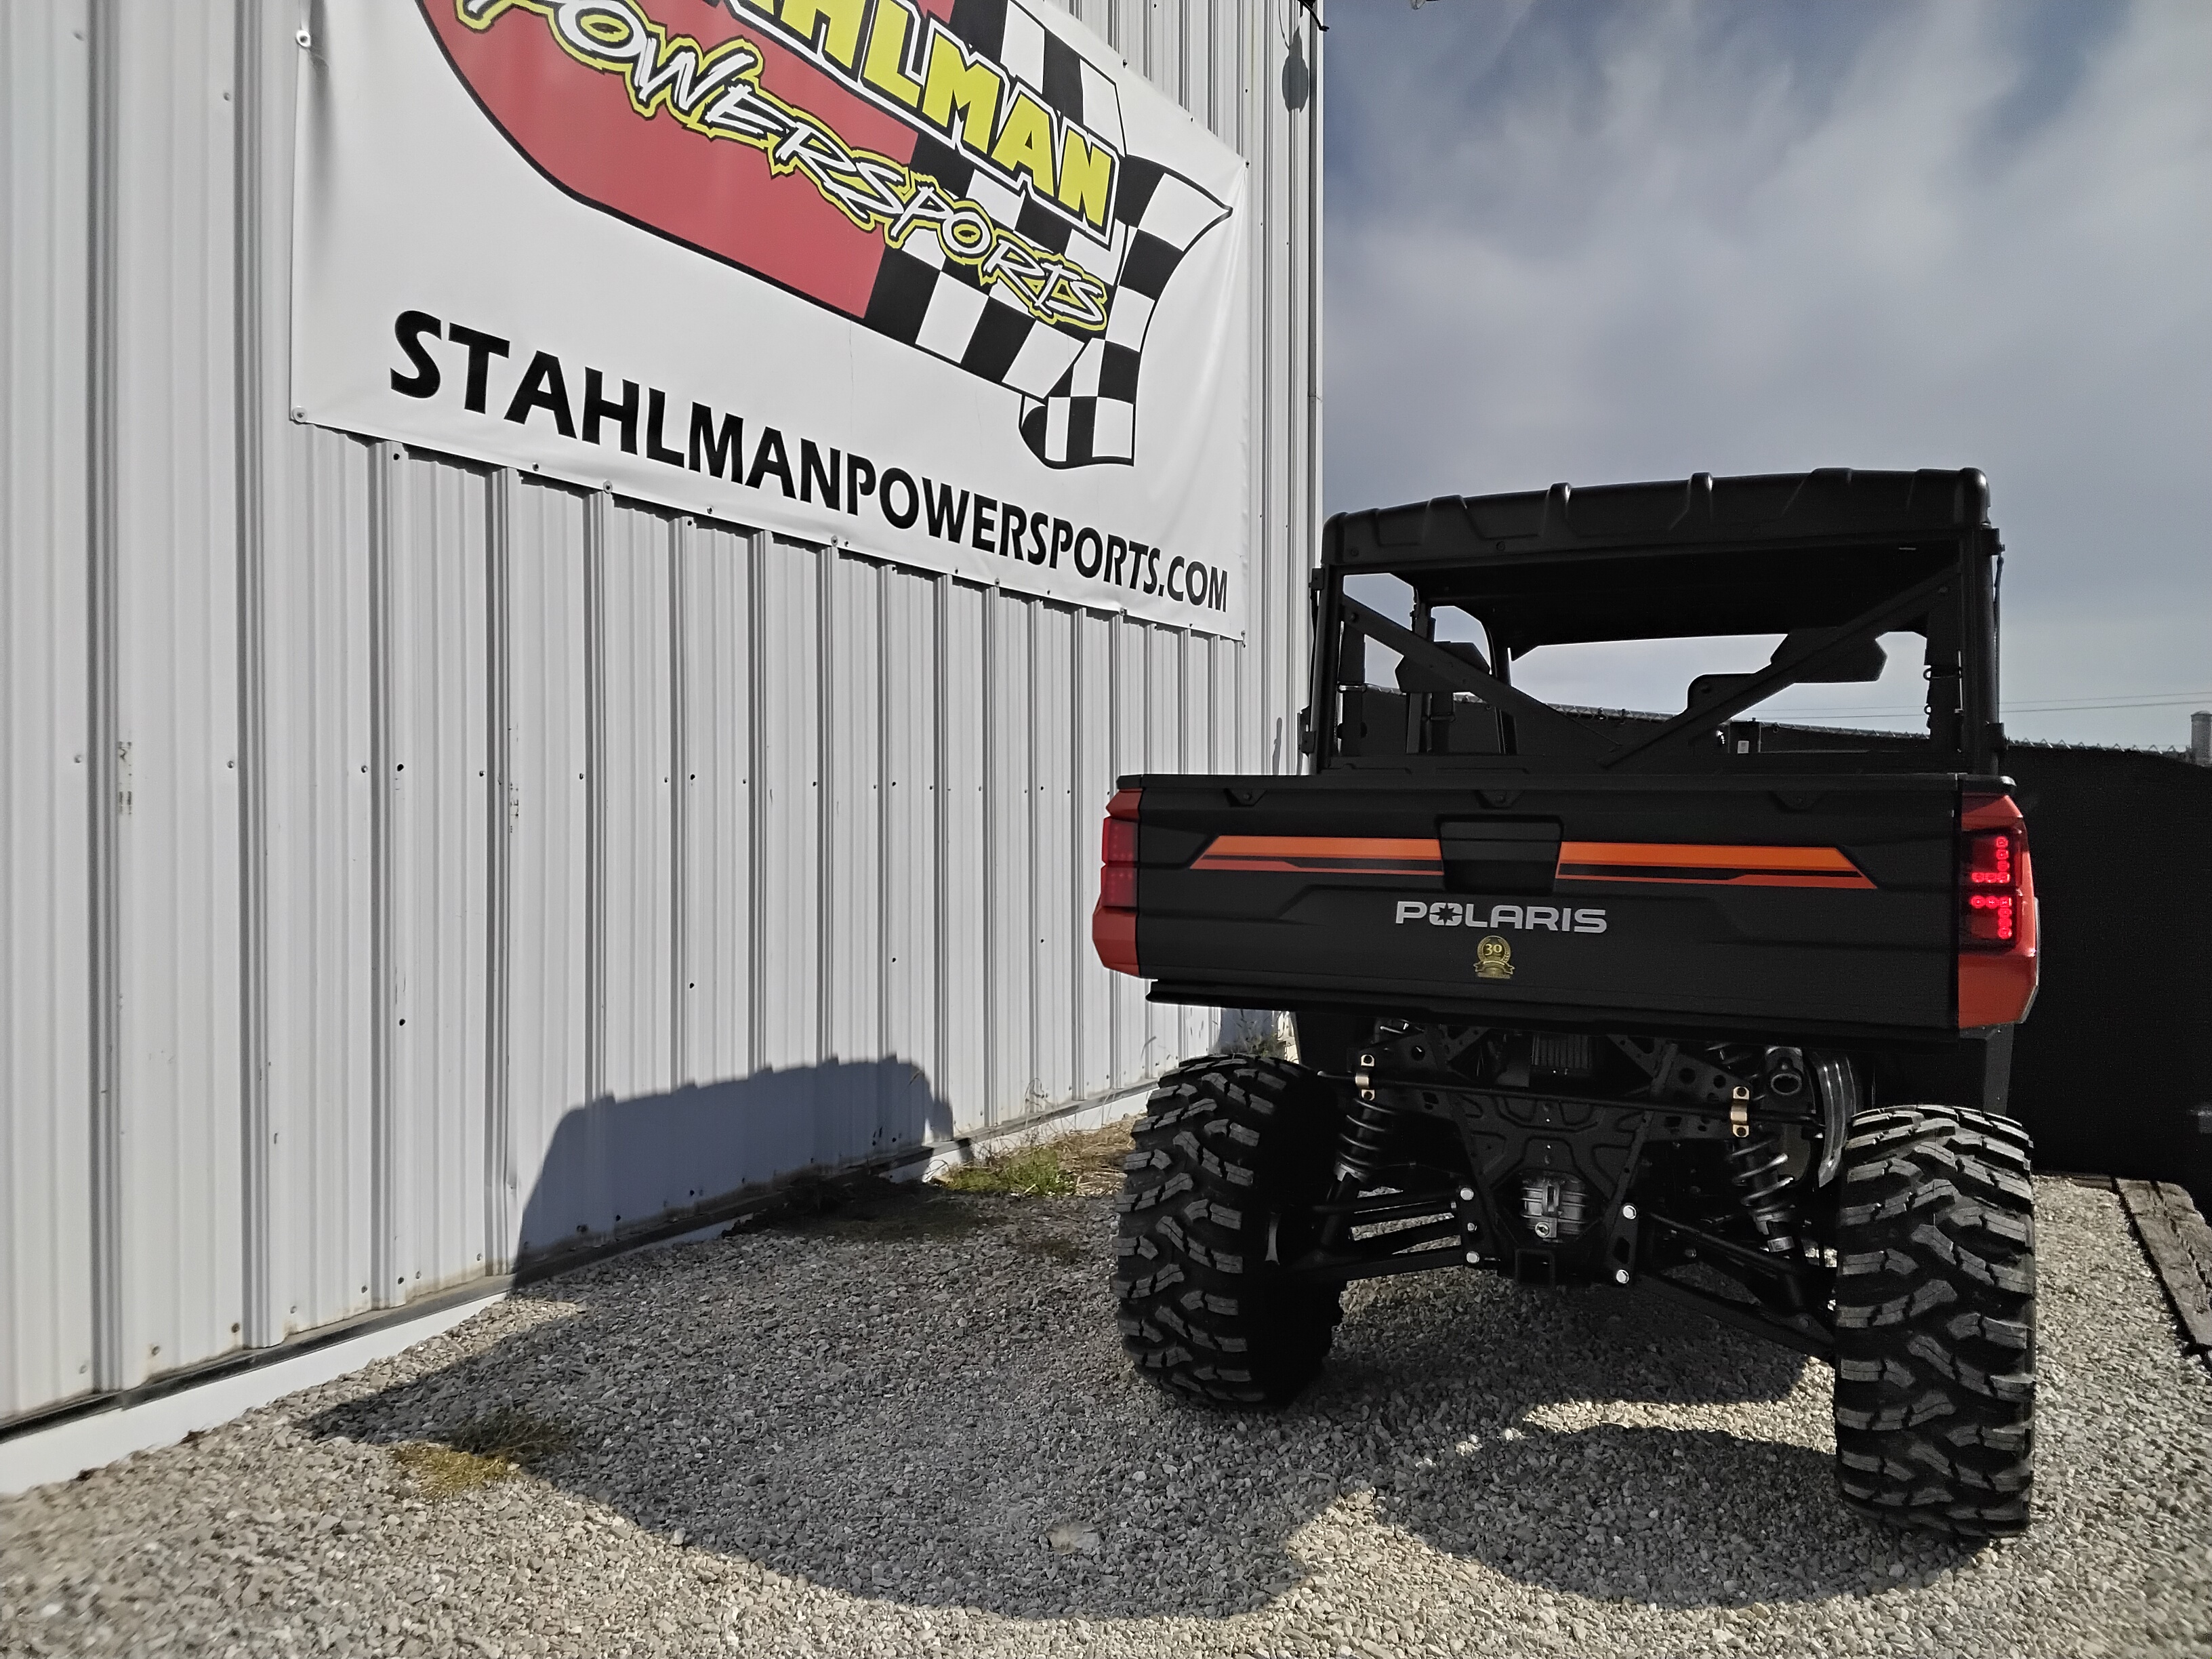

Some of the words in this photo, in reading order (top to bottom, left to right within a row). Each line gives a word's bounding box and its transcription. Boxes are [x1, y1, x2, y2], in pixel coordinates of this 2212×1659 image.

[466, 0, 1107, 325] OWERSPORTS
[390, 310, 1227, 613] STAHLMANPOWERSPORTS.COM
[1395, 901, 1607, 933] POLARIS
[1484, 943, 1502, 956] 30
